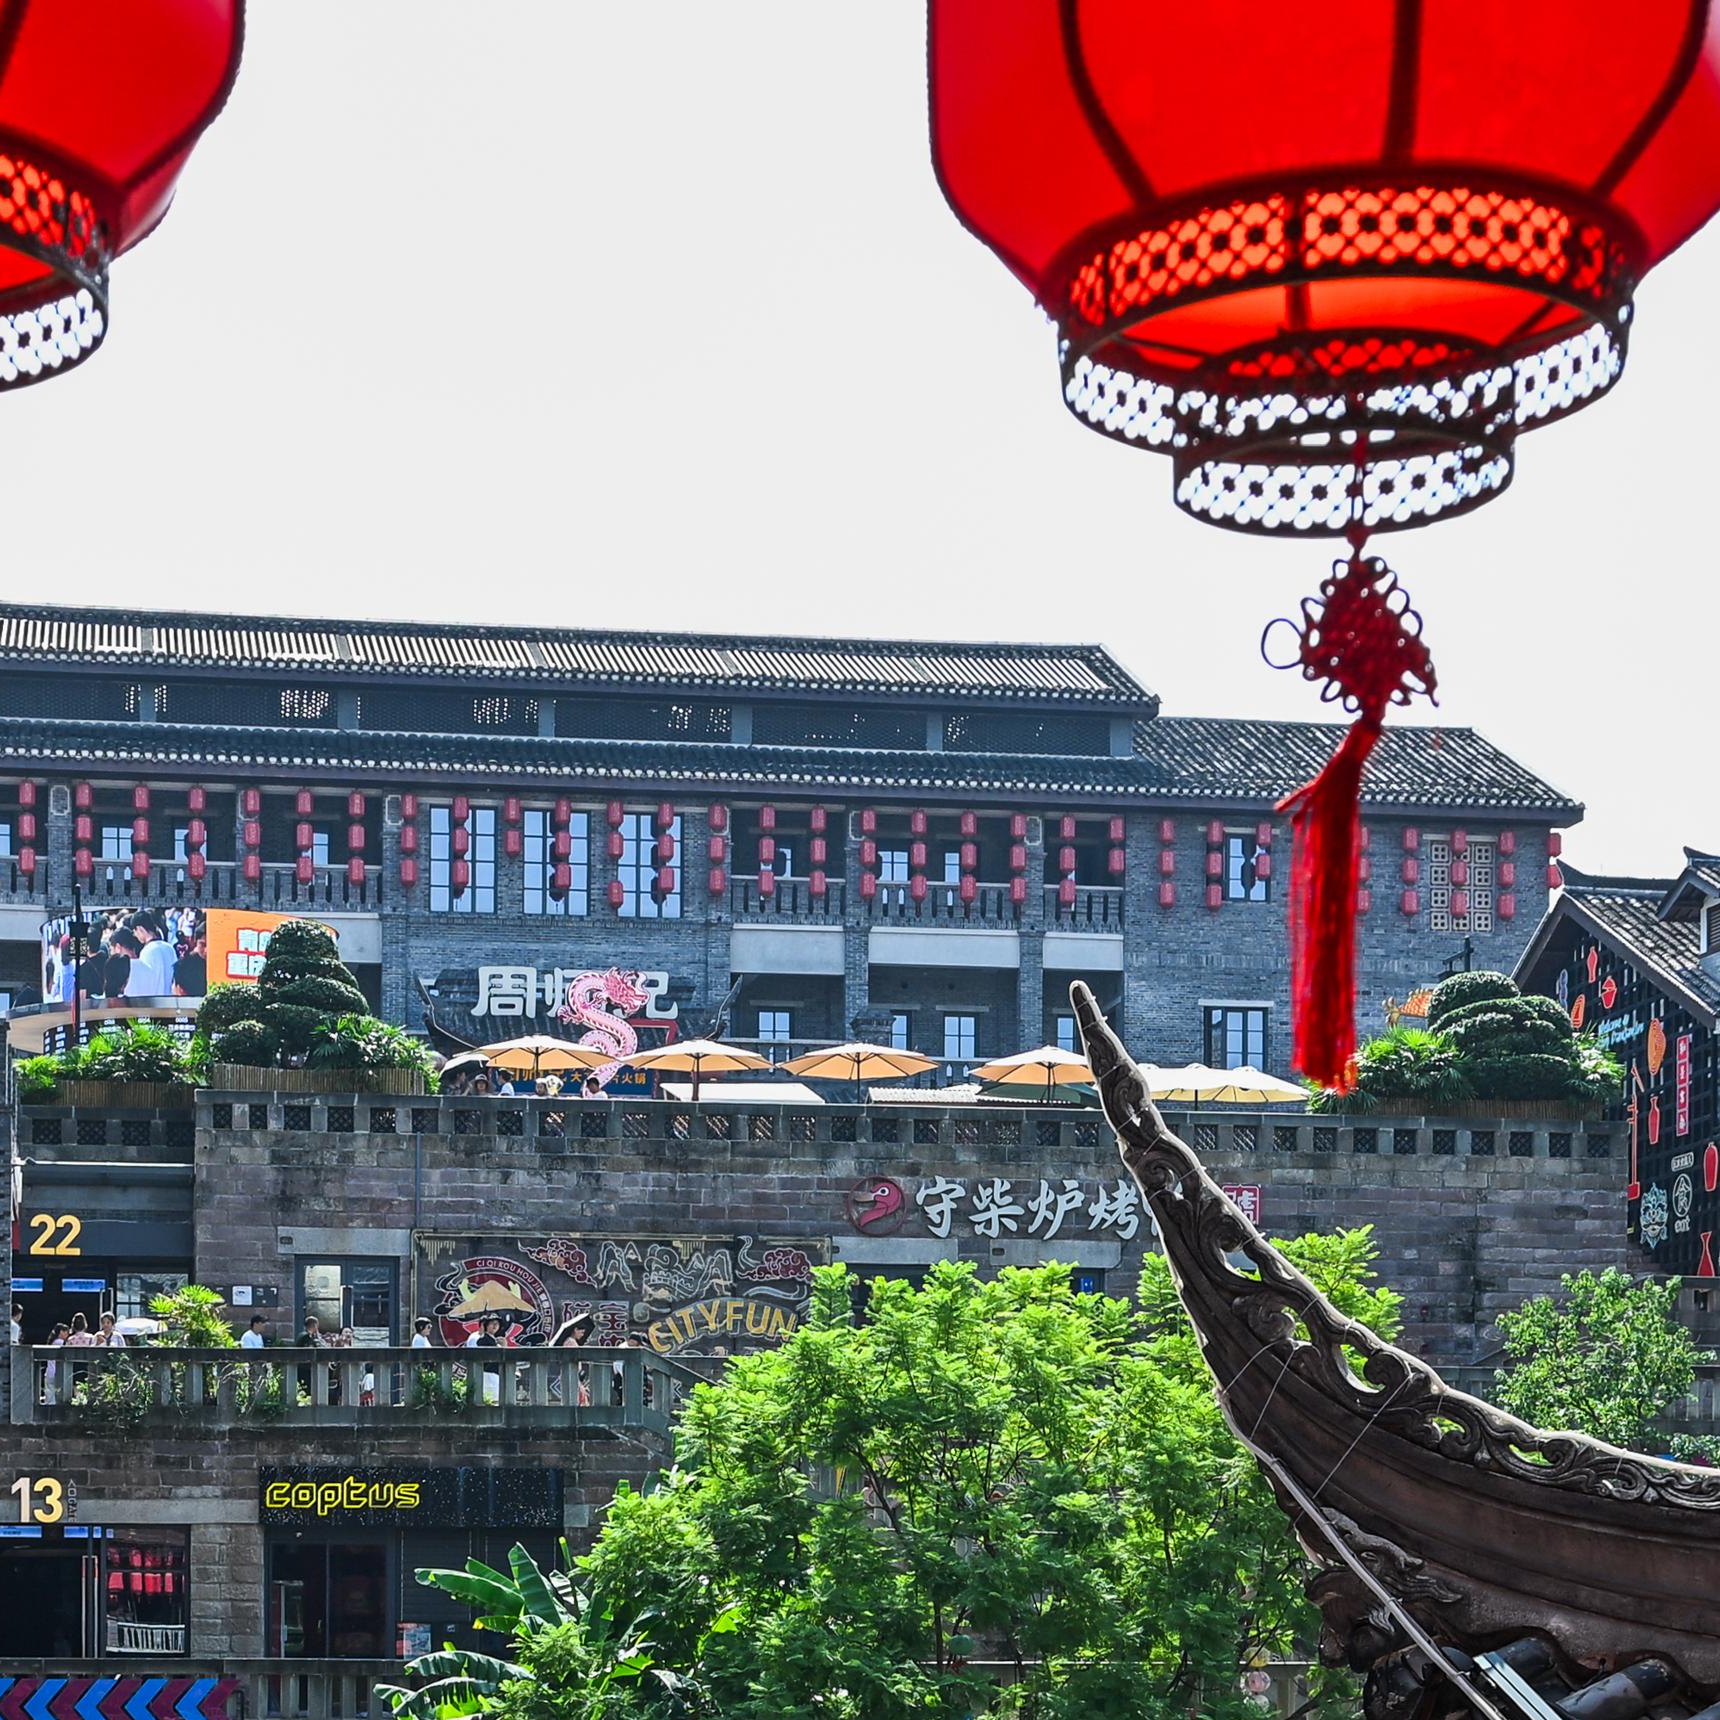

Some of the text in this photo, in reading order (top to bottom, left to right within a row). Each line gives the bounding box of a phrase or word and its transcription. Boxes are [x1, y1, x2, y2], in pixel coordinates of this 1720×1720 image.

[915, 1175, 1165, 1240] 守柴炉烤
[30, 1213, 81, 1256] 22
[498, 1260, 516, 1272] KOU
[516, 1267, 534, 1283] HOU
[11, 1477, 63, 1523] 13
